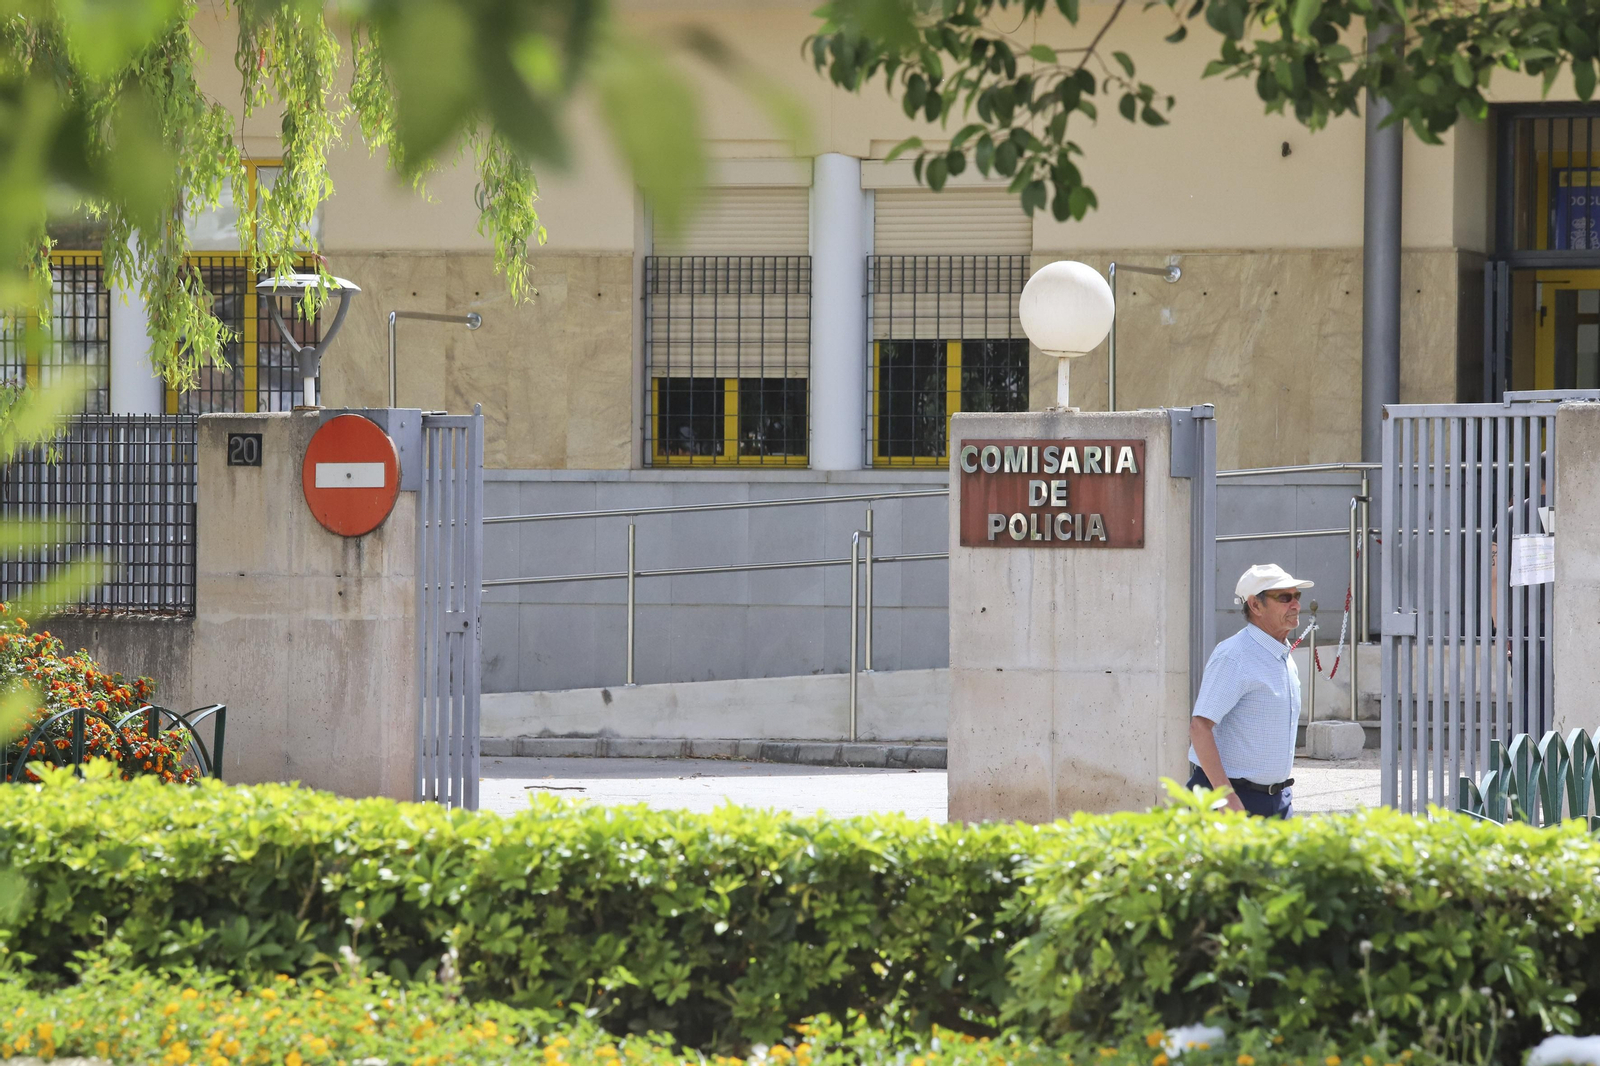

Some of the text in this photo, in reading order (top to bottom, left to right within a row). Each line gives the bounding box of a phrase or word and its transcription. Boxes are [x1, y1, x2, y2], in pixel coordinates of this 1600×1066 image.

[230, 436, 258, 463] 20
[960, 445, 1138, 474] COMISARIA
[1028, 479, 1067, 507] DE
[987, 512, 1107, 541] POLICIA
